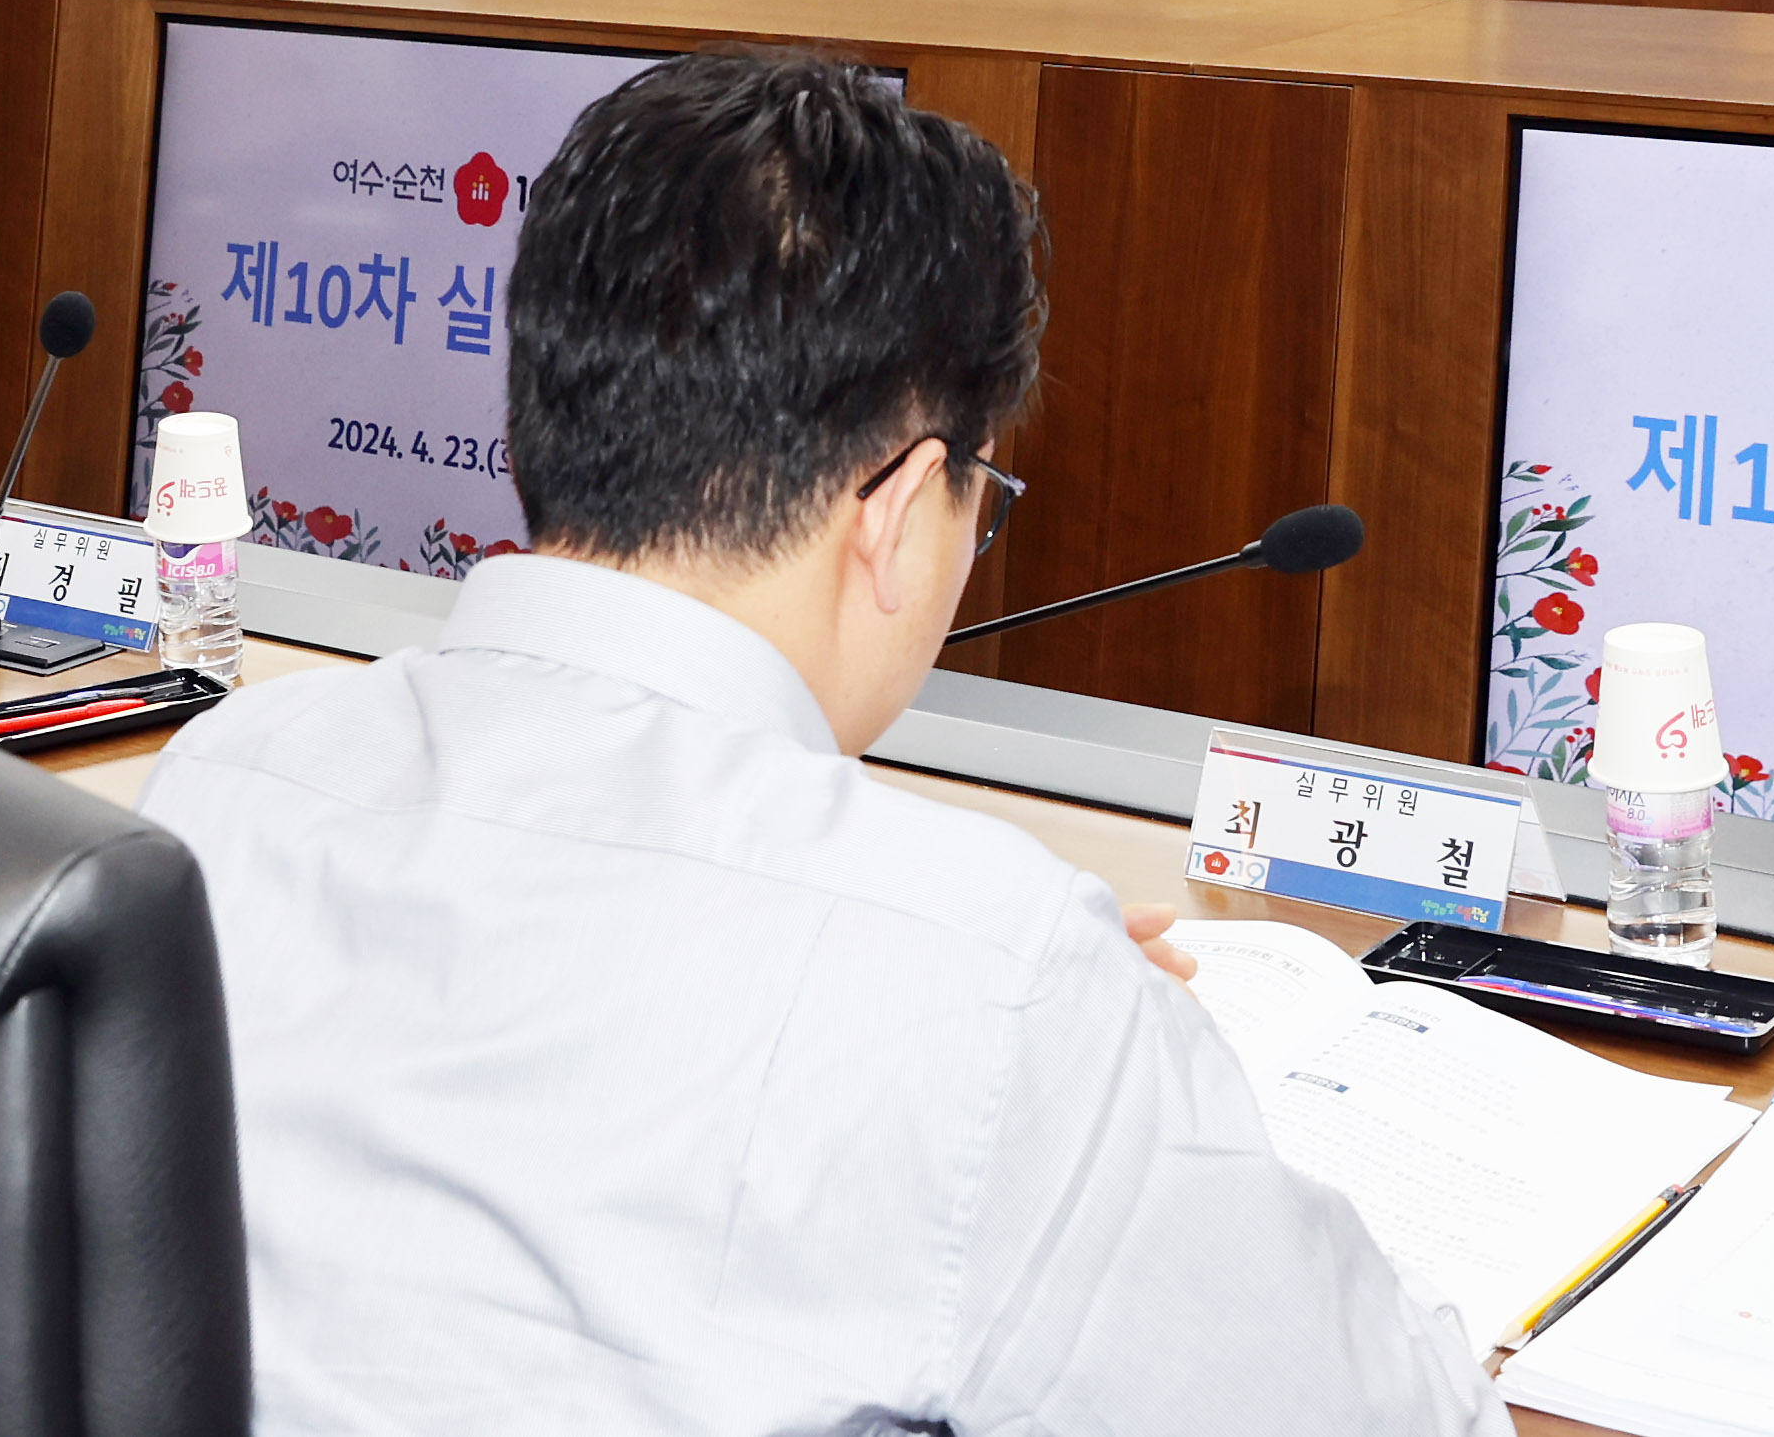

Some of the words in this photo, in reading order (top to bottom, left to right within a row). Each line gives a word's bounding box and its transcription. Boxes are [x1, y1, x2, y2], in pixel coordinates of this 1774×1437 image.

[333, 159, 446, 204] 여수·순천
[220, 240, 417, 346] 제10차
[328, 417, 403, 460] 2024.
[411, 430, 435, 464] 4.
[179, 477, 229, 499] 꿈드래
